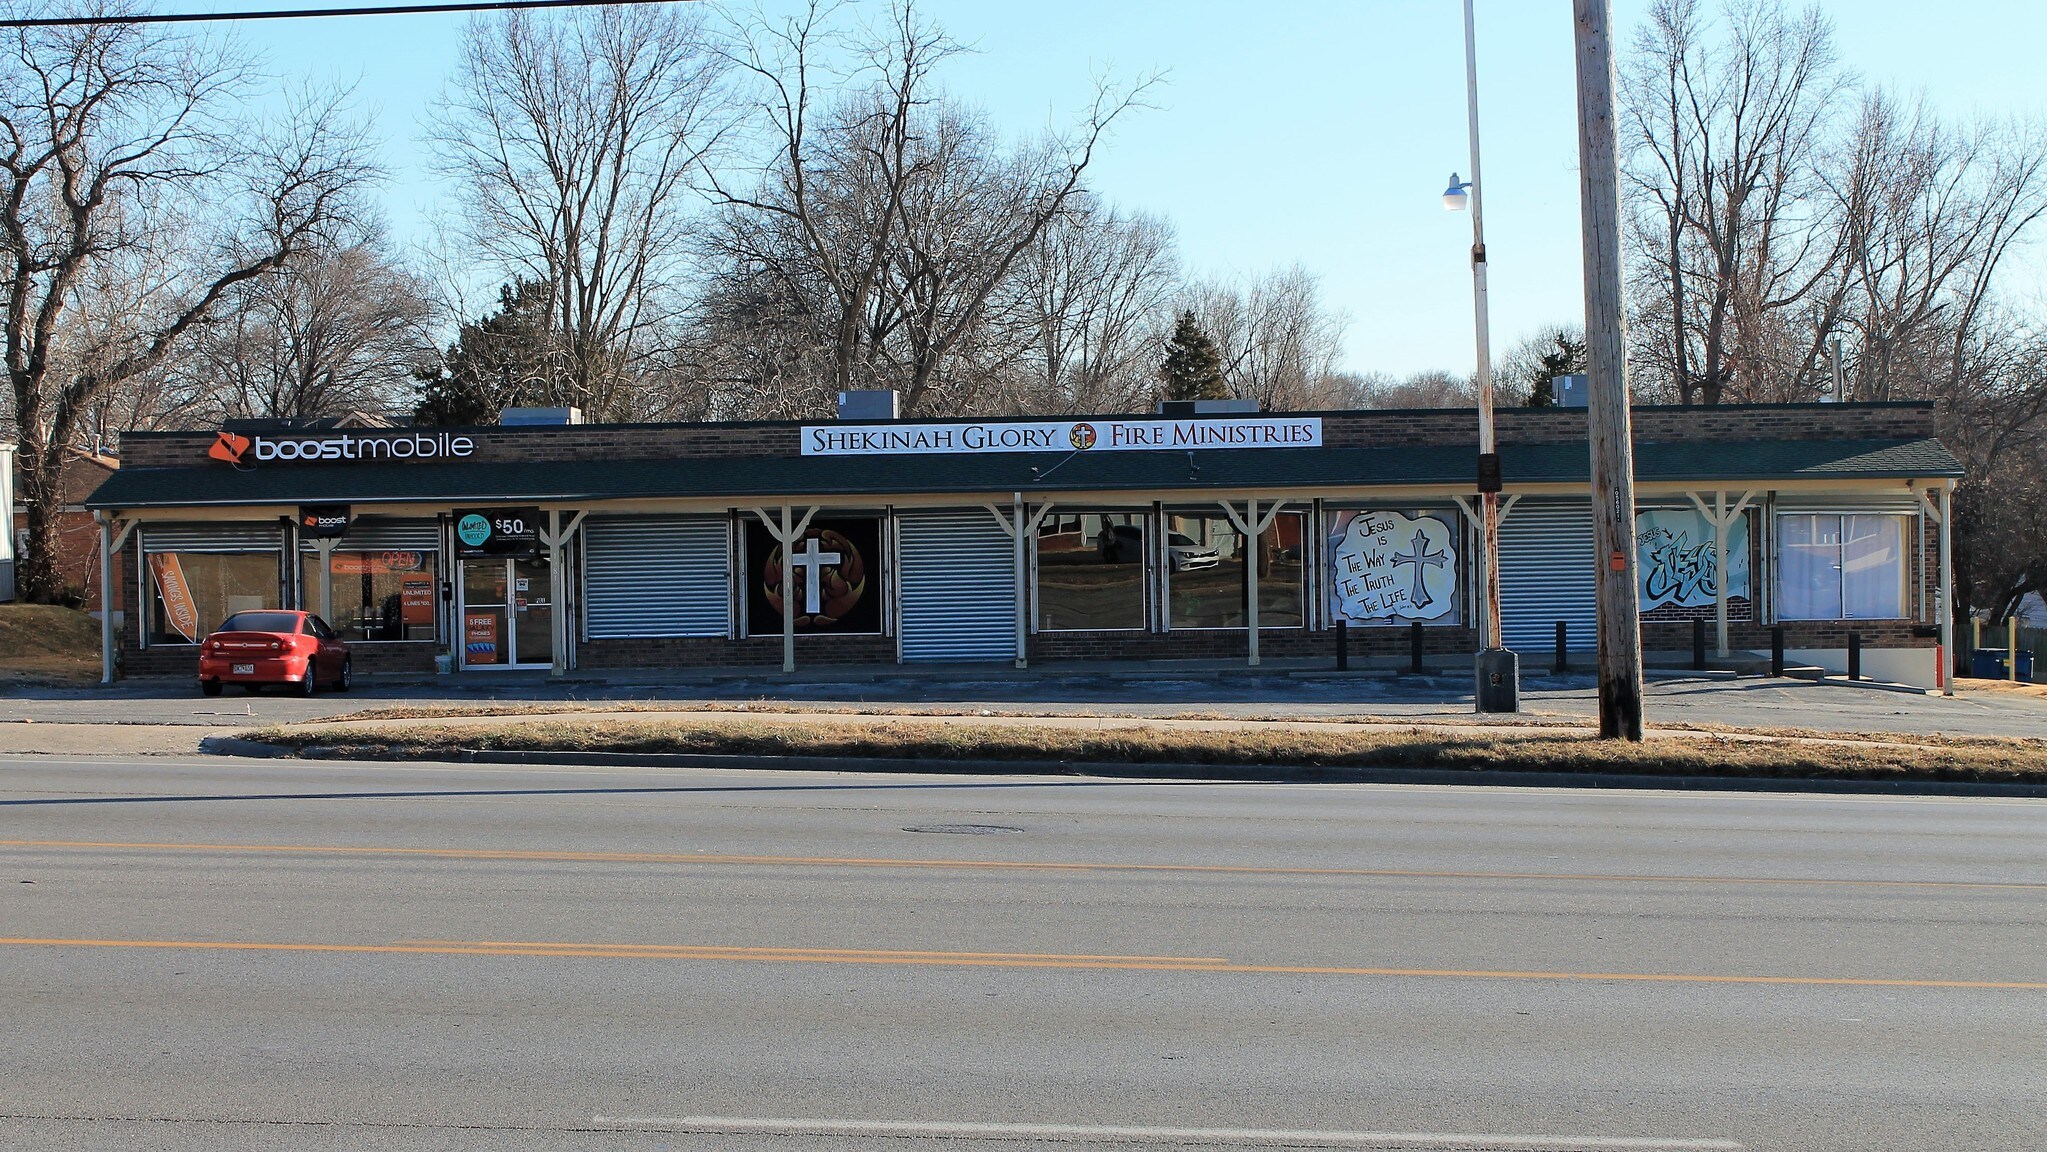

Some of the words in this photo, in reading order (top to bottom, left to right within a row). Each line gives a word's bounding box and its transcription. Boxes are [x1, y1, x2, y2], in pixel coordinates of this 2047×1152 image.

[255, 432, 474, 461] boostmobile
[812, 428, 952, 452] SHEKINAH
[962, 426, 1057, 449] GLORY
[1111, 424, 1164, 447] FIRE
[1172, 422, 1313, 446] MINISTRIES
[318, 515, 347, 525] boost
[1359, 517, 1395, 538] JESUS
[1637, 527, 1661, 546] JESUS
[382, 552, 415, 567] OPEN
[1341, 554, 1362, 573] THE
[1363, 548, 1385, 568] WAY
[1341, 579, 1360, 597] THE
[1359, 573, 1395, 591] TRUTH
[162, 570, 183, 602] SAVINGS
[174, 601, 194, 630] INSIDE
[1358, 597, 1379, 614] THE
[1380, 589, 1407, 609] LIFE
